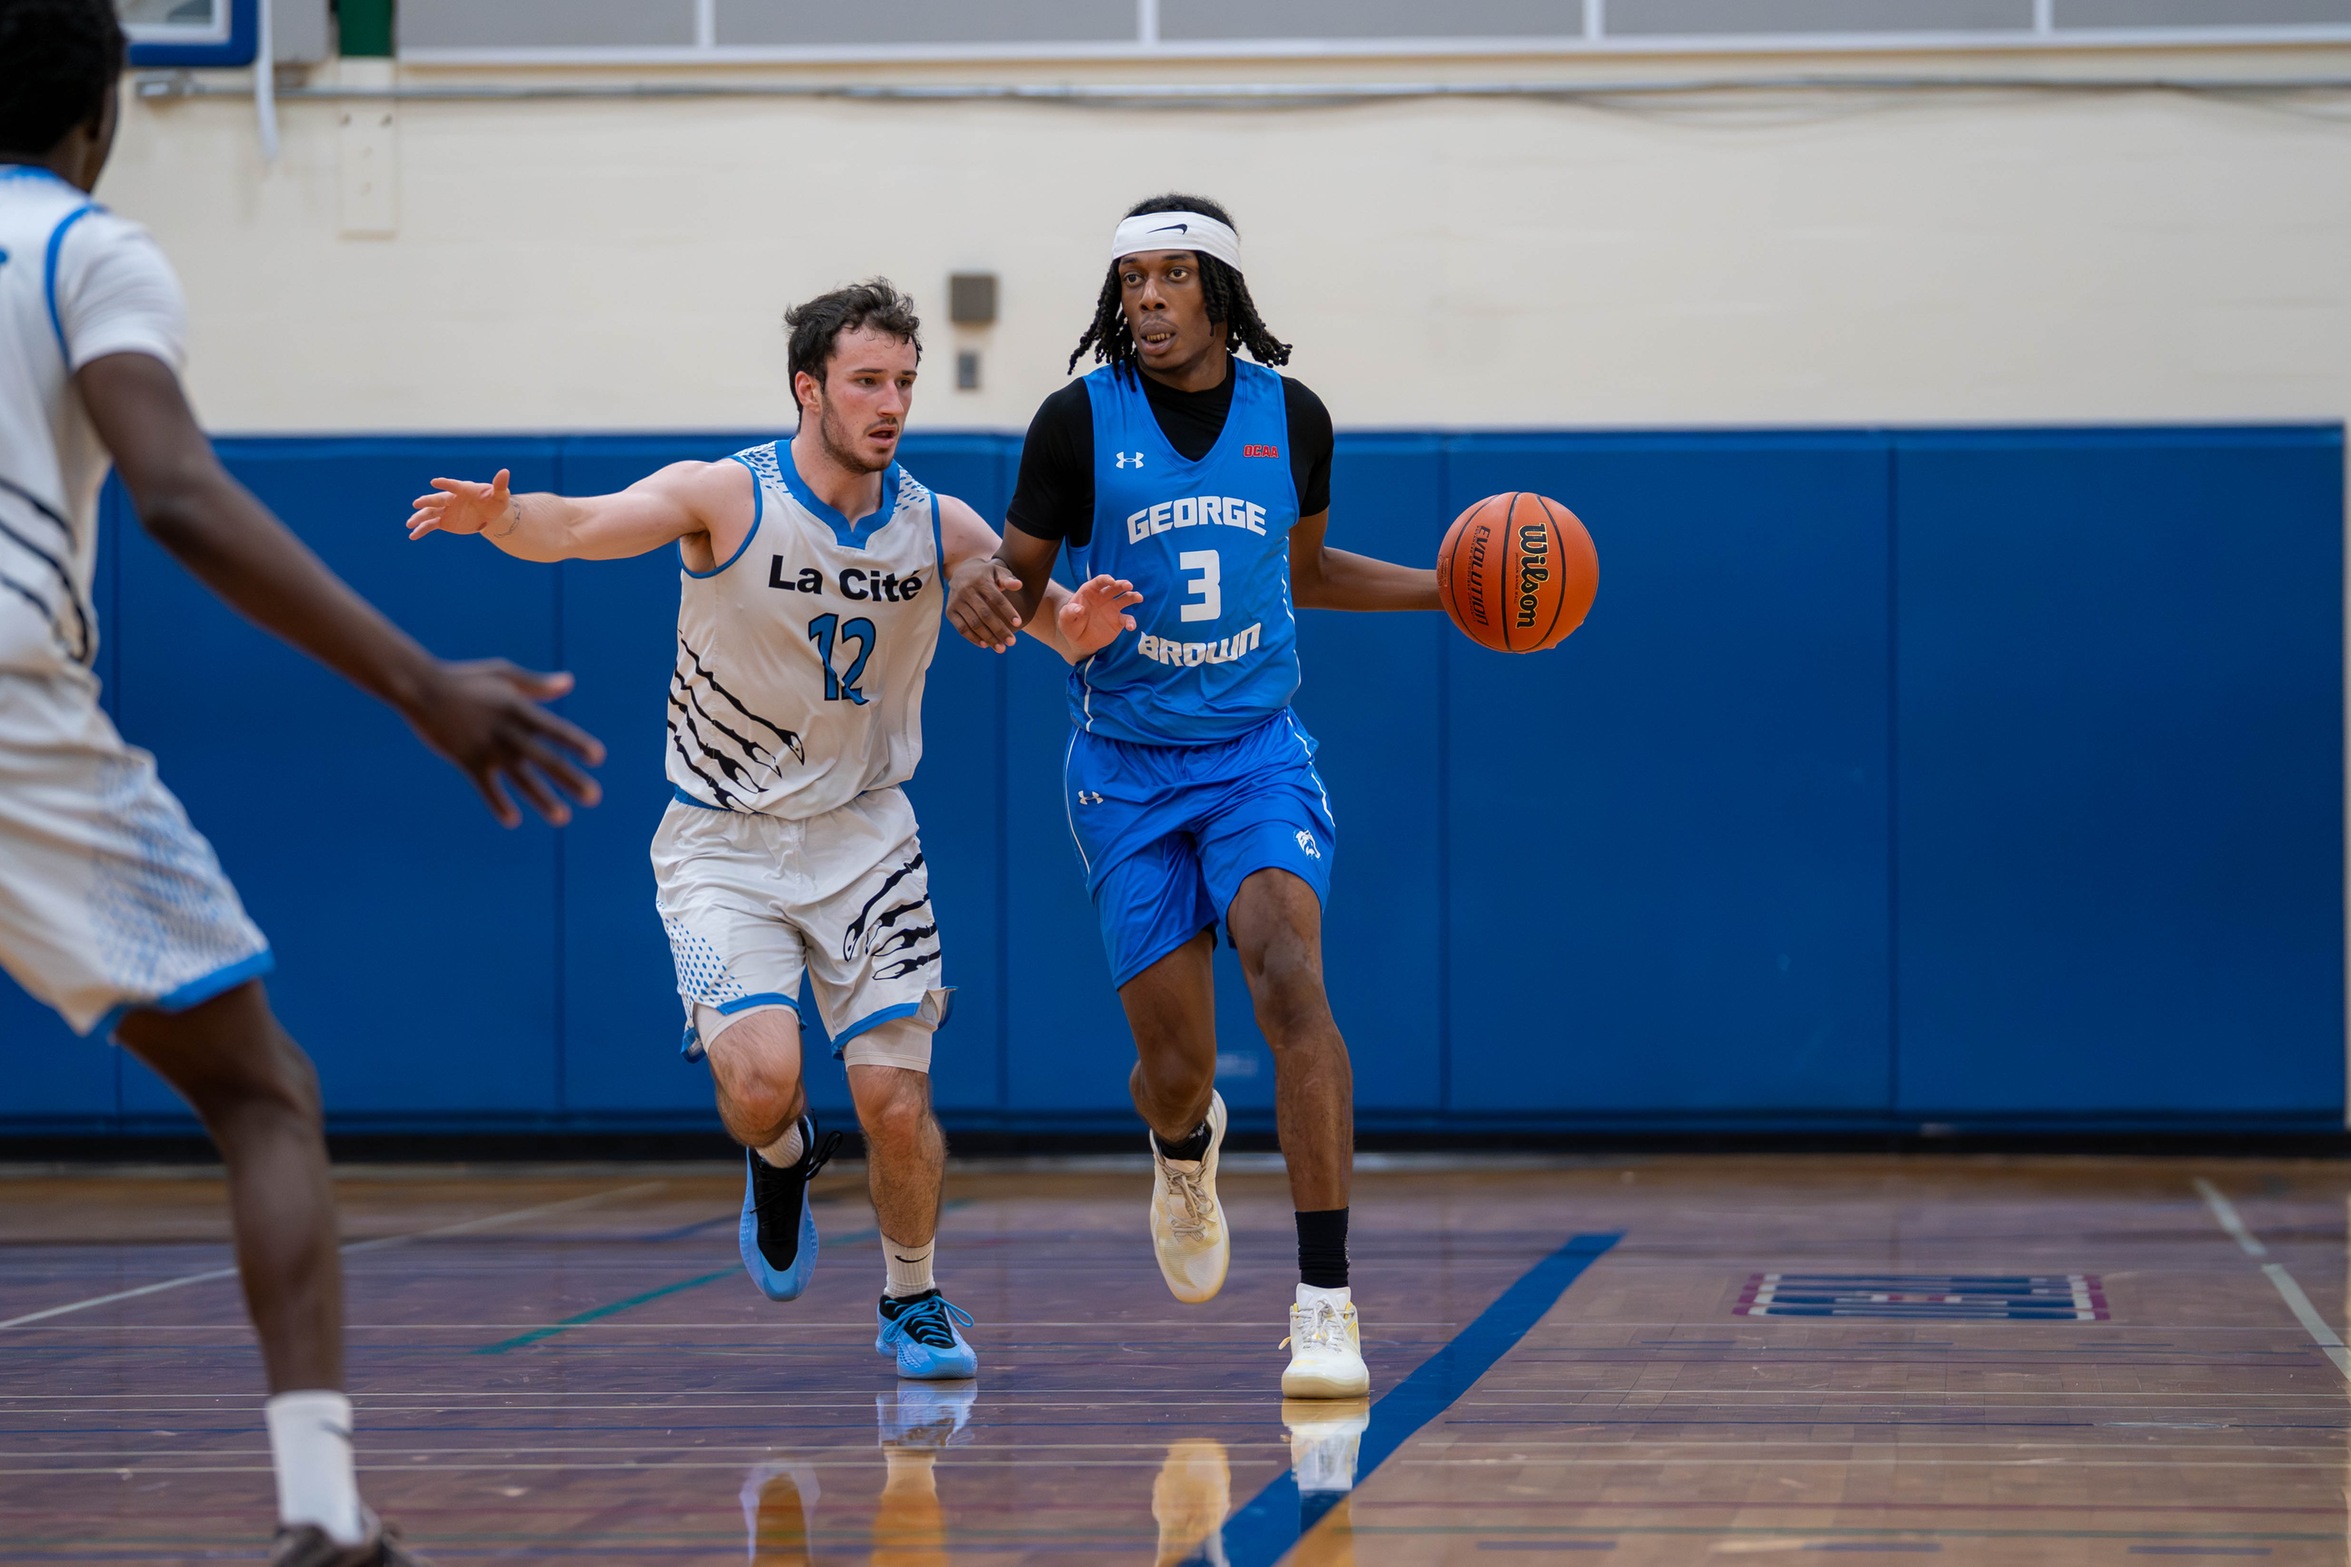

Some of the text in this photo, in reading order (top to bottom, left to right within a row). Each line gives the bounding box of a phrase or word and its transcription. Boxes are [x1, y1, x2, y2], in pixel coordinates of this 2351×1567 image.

[1243, 444, 1279, 459] OCAA
[1126, 495, 1267, 545] GEORGE
[768, 554, 923, 603] La Cité
[1179, 549, 1222, 623] 3
[1471, 525, 1491, 627] EVOLUTION
[1516, 523, 1549, 628] Wilson
[808, 612, 877, 706] 12
[1137, 622, 1262, 668] BROWN
